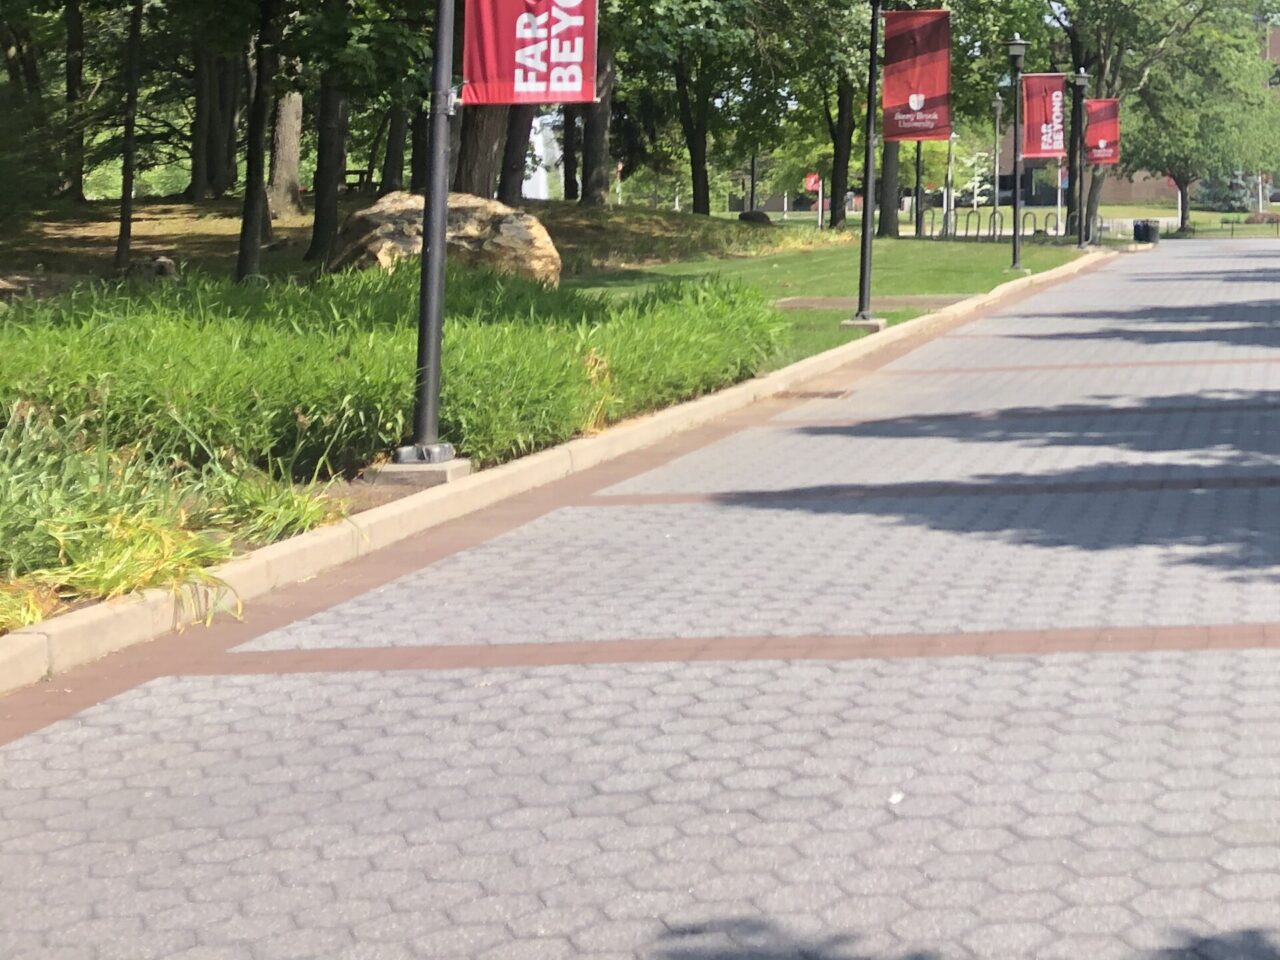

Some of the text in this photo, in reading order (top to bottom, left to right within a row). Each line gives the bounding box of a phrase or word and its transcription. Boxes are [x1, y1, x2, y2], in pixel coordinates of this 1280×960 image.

[514, 11, 549, 94] FAR
[1041, 123, 1053, 150] FAR
[1052, 90, 1064, 150] BEYOND
